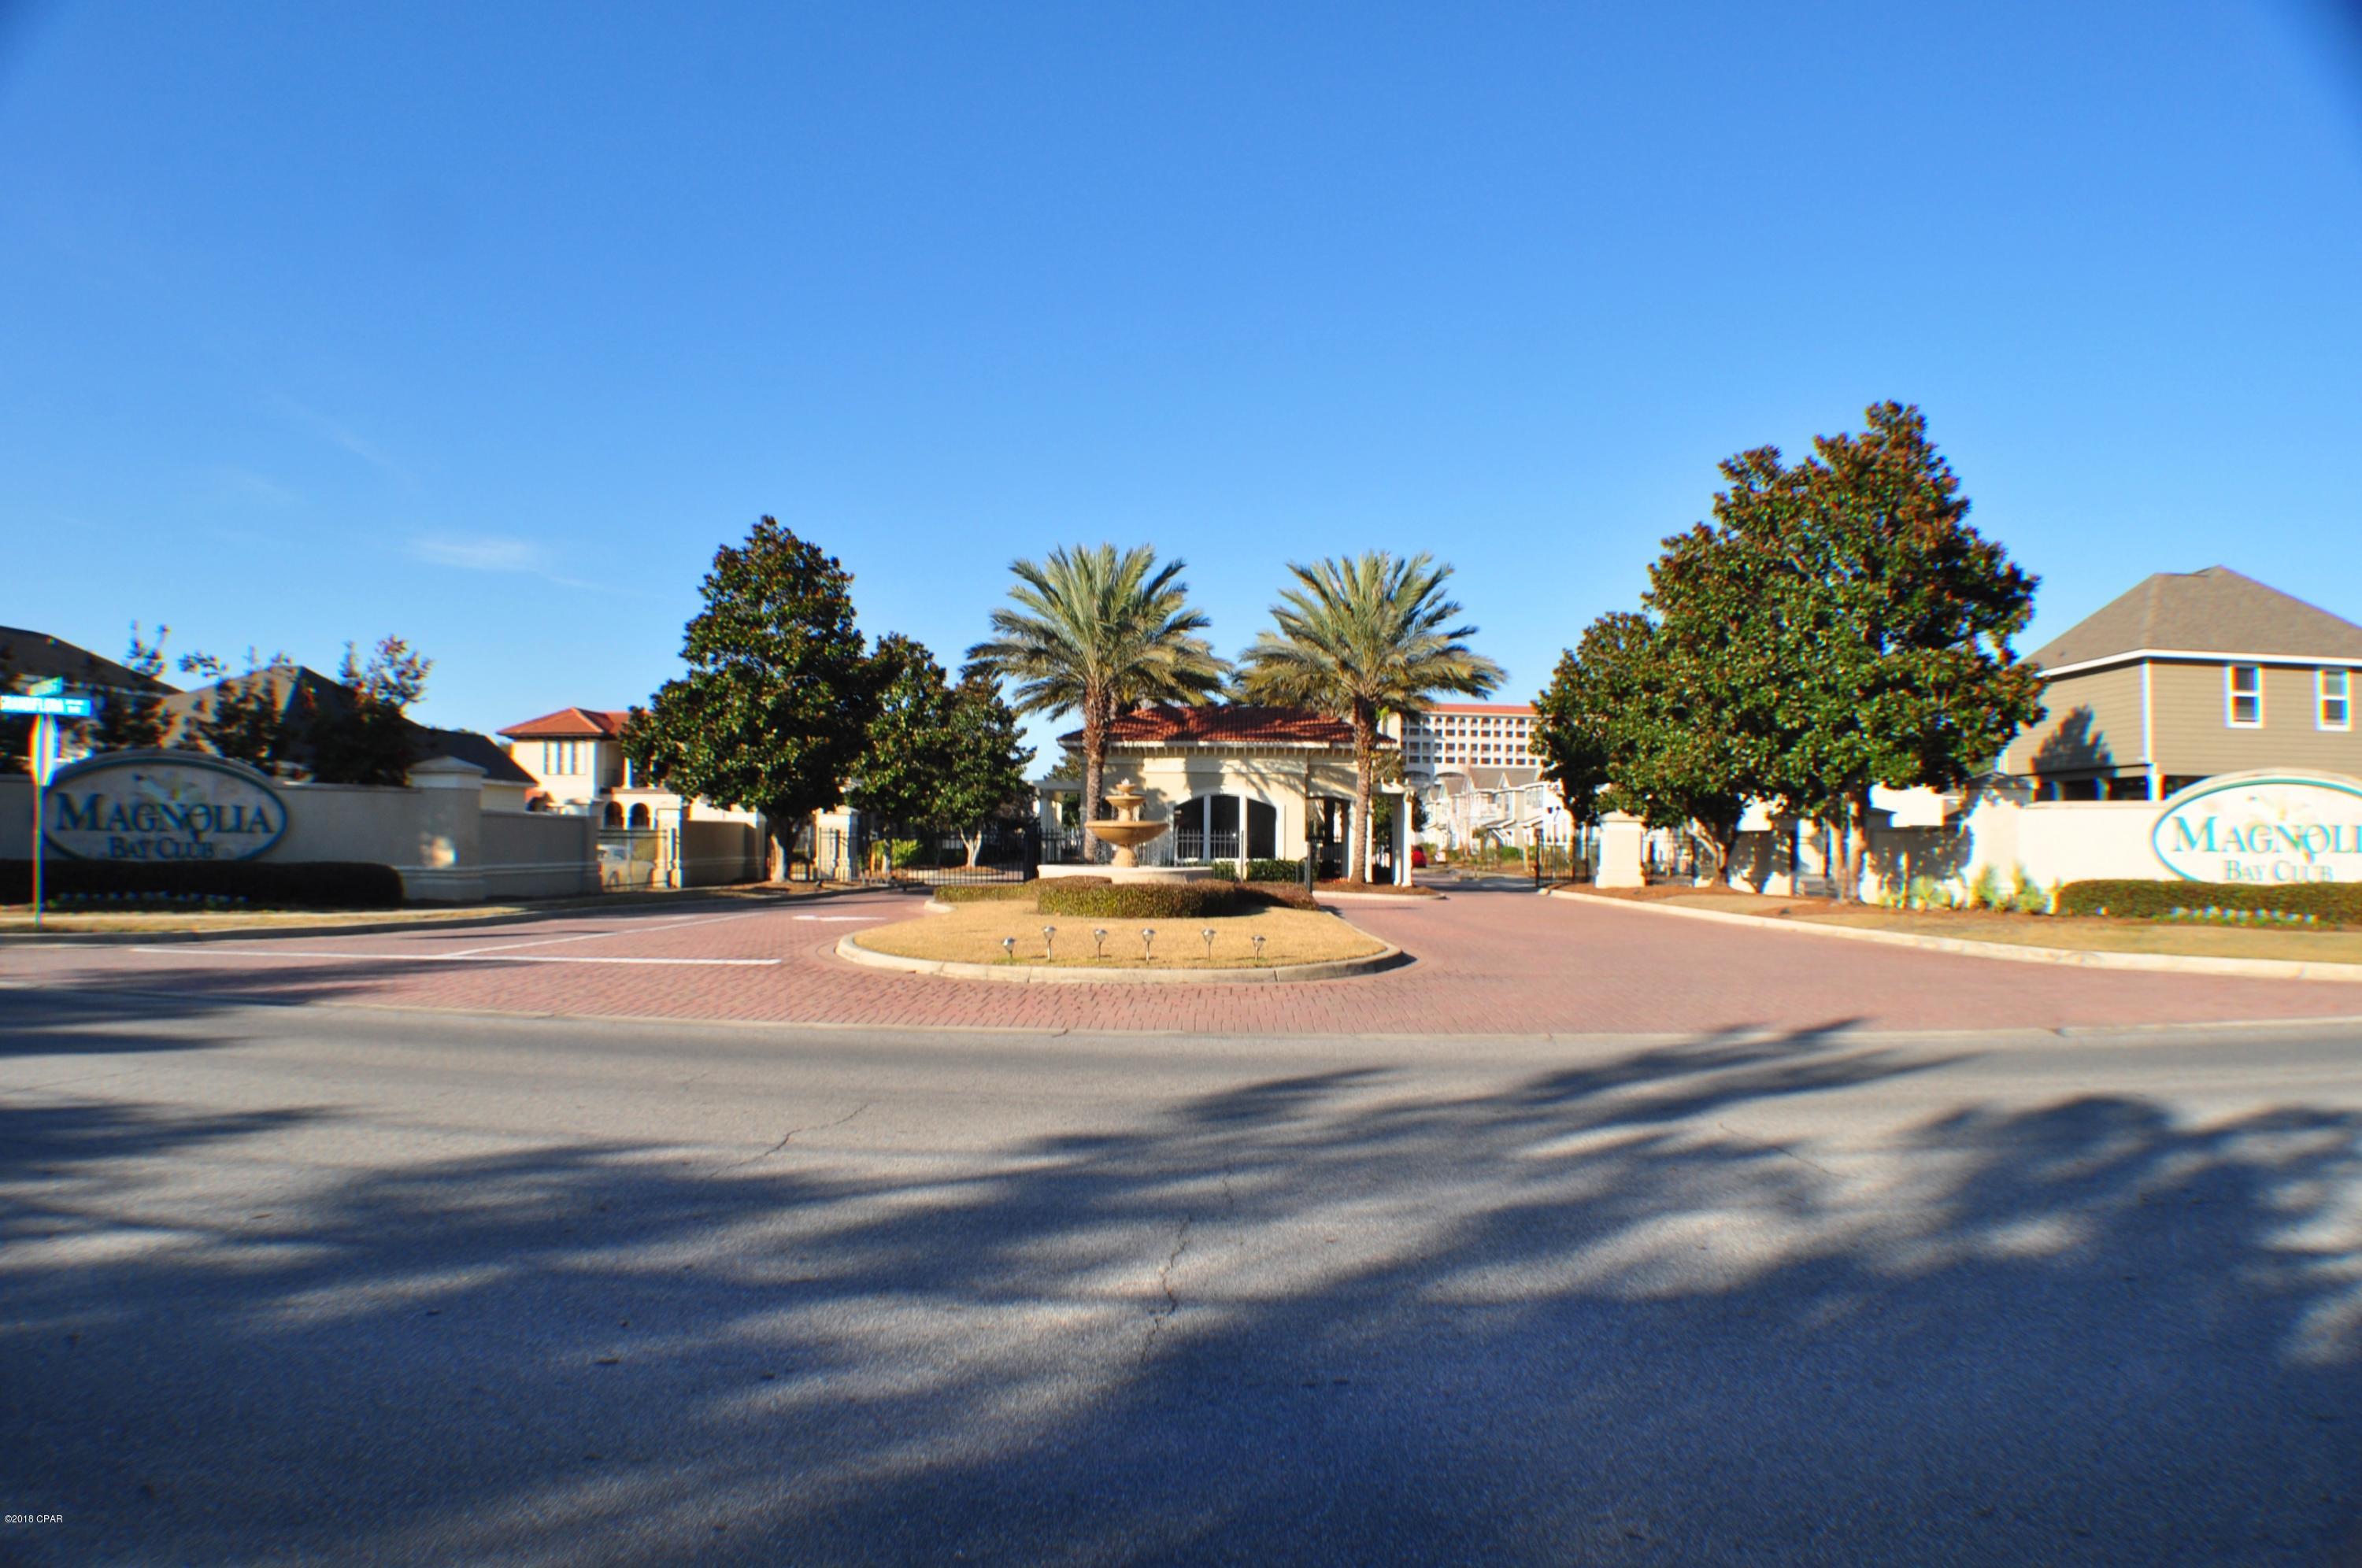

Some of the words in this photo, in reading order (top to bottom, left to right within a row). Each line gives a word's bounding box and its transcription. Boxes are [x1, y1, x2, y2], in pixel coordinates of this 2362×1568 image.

[56, 792, 275, 834] MAGNOLIA
[109, 837, 153, 858] BAY
[156, 837, 215, 859] CLUB
[2171, 815, 2362, 854] MAGNOLI
[2223, 860, 2266, 882] BAY
[2272, 860, 2334, 882] CLUB
